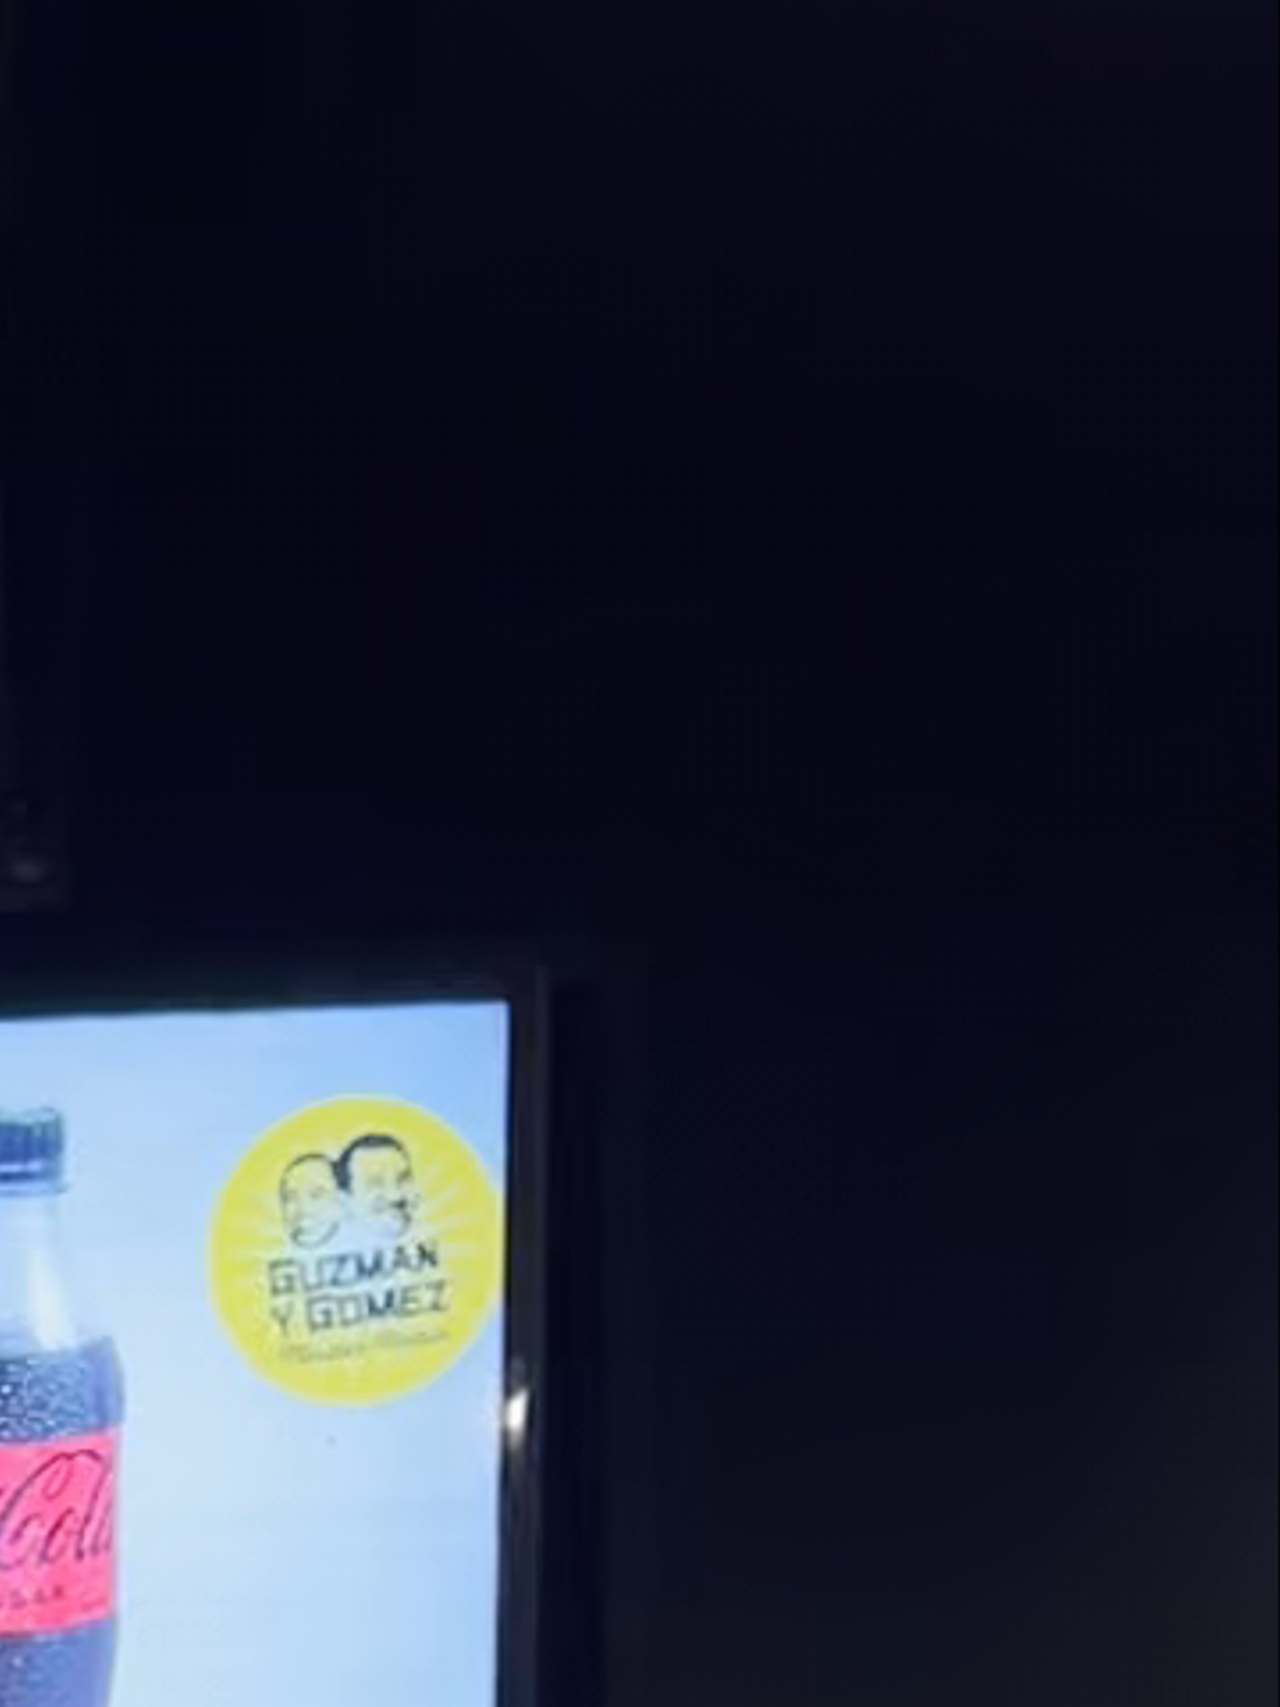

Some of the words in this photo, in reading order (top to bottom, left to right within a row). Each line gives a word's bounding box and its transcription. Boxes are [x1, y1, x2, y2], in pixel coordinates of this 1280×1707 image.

[268, 1242, 438, 1295] GUZMAN
[271, 1301, 293, 1337] Y
[307, 1280, 450, 1331] GOMEZ
